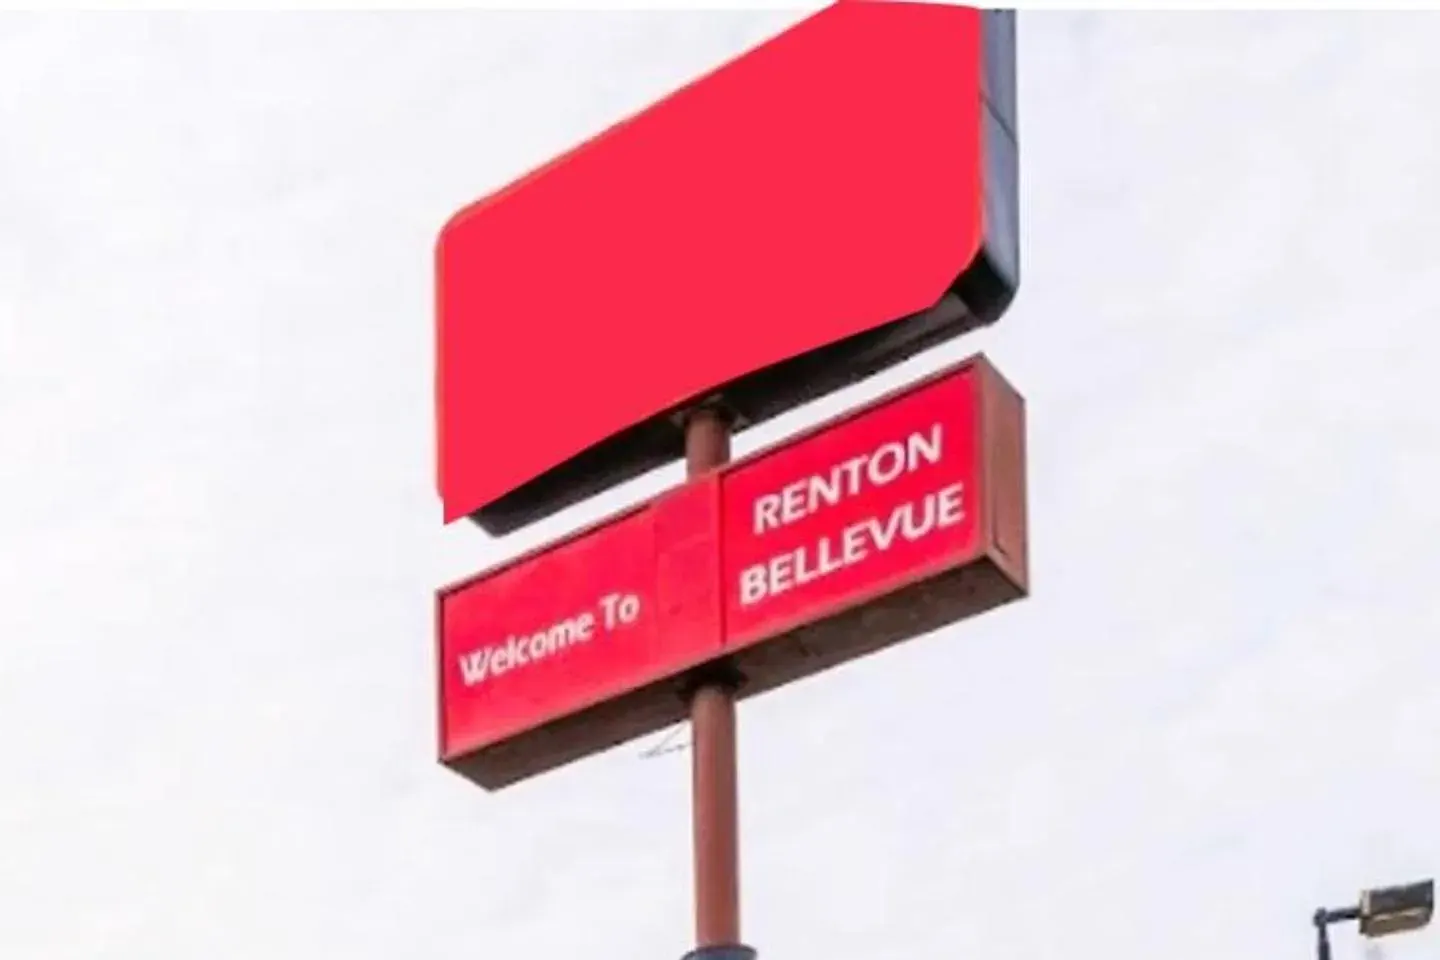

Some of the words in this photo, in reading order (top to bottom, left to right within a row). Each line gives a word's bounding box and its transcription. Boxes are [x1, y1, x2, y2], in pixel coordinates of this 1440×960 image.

[753, 422, 943, 535] RENTON
[739, 480, 966, 606] BELLEVUE
[458, 612, 595, 687] Welcome
[600, 592, 641, 632] To
